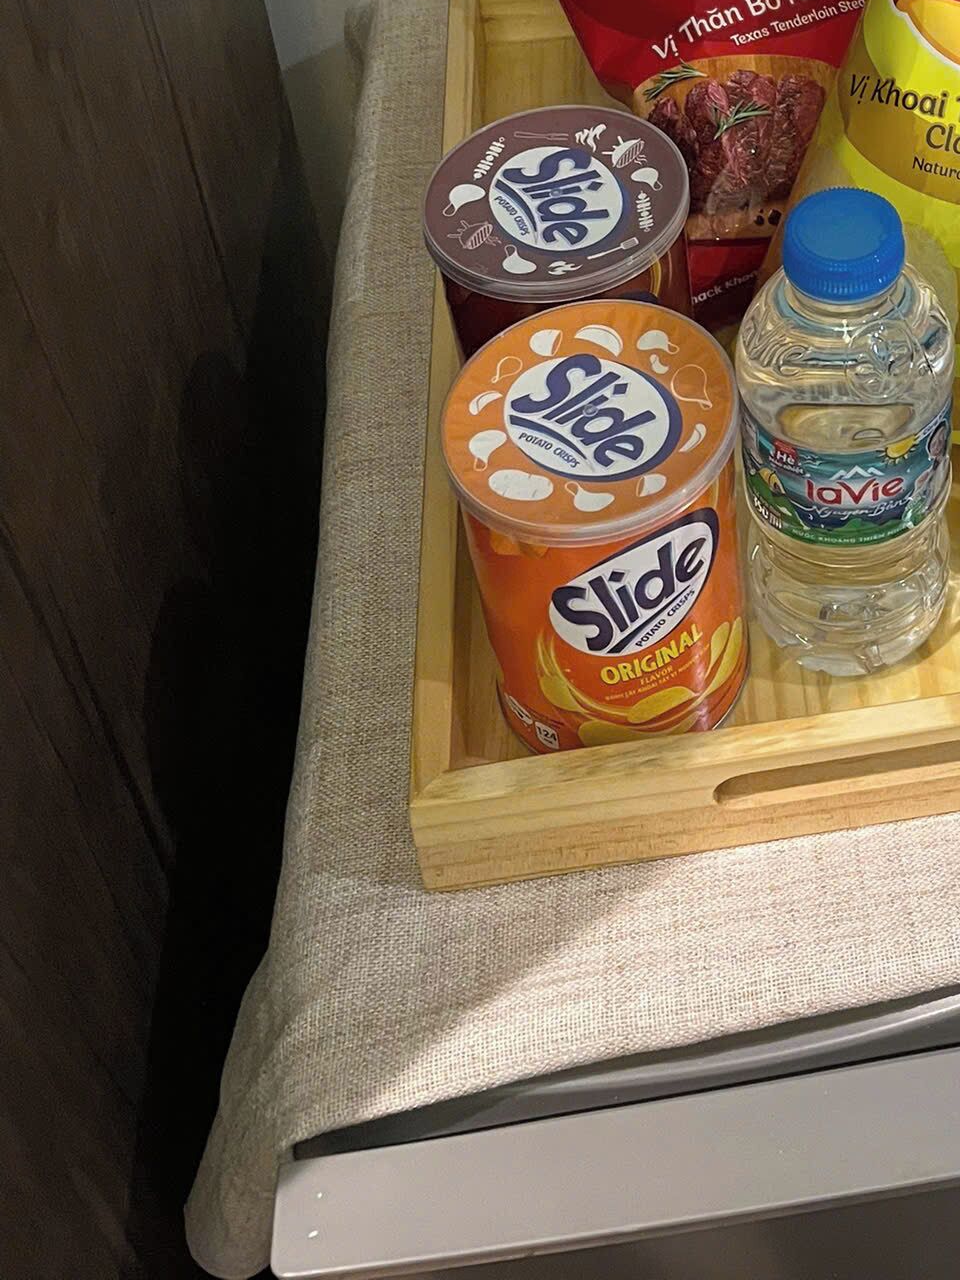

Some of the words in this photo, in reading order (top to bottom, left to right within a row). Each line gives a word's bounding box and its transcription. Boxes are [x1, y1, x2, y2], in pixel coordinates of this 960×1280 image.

[652, 34, 679, 59] Vị
[678, 5, 744, 43] Thăn
[730, 27, 770, 47] Texas
[770, 2, 838, 33] Tenderloin
[848, 73, 870, 105] Vị
[871, 81, 947, 118] Khoai
[502, 149, 610, 246] Slide
[690, 285, 722, 305] nack
[510, 353, 656, 468] Slide
[518, 432, 553, 451] POTATO
[553, 447, 580, 468] CRISPS
[551, 536, 707, 652] Slide
[635, 618, 666, 647] POTATO
[667, 589, 695, 617] CRISPS
[600, 623, 703, 685] ORIGINAL
[640, 665, 673, 685] FLAVOR
